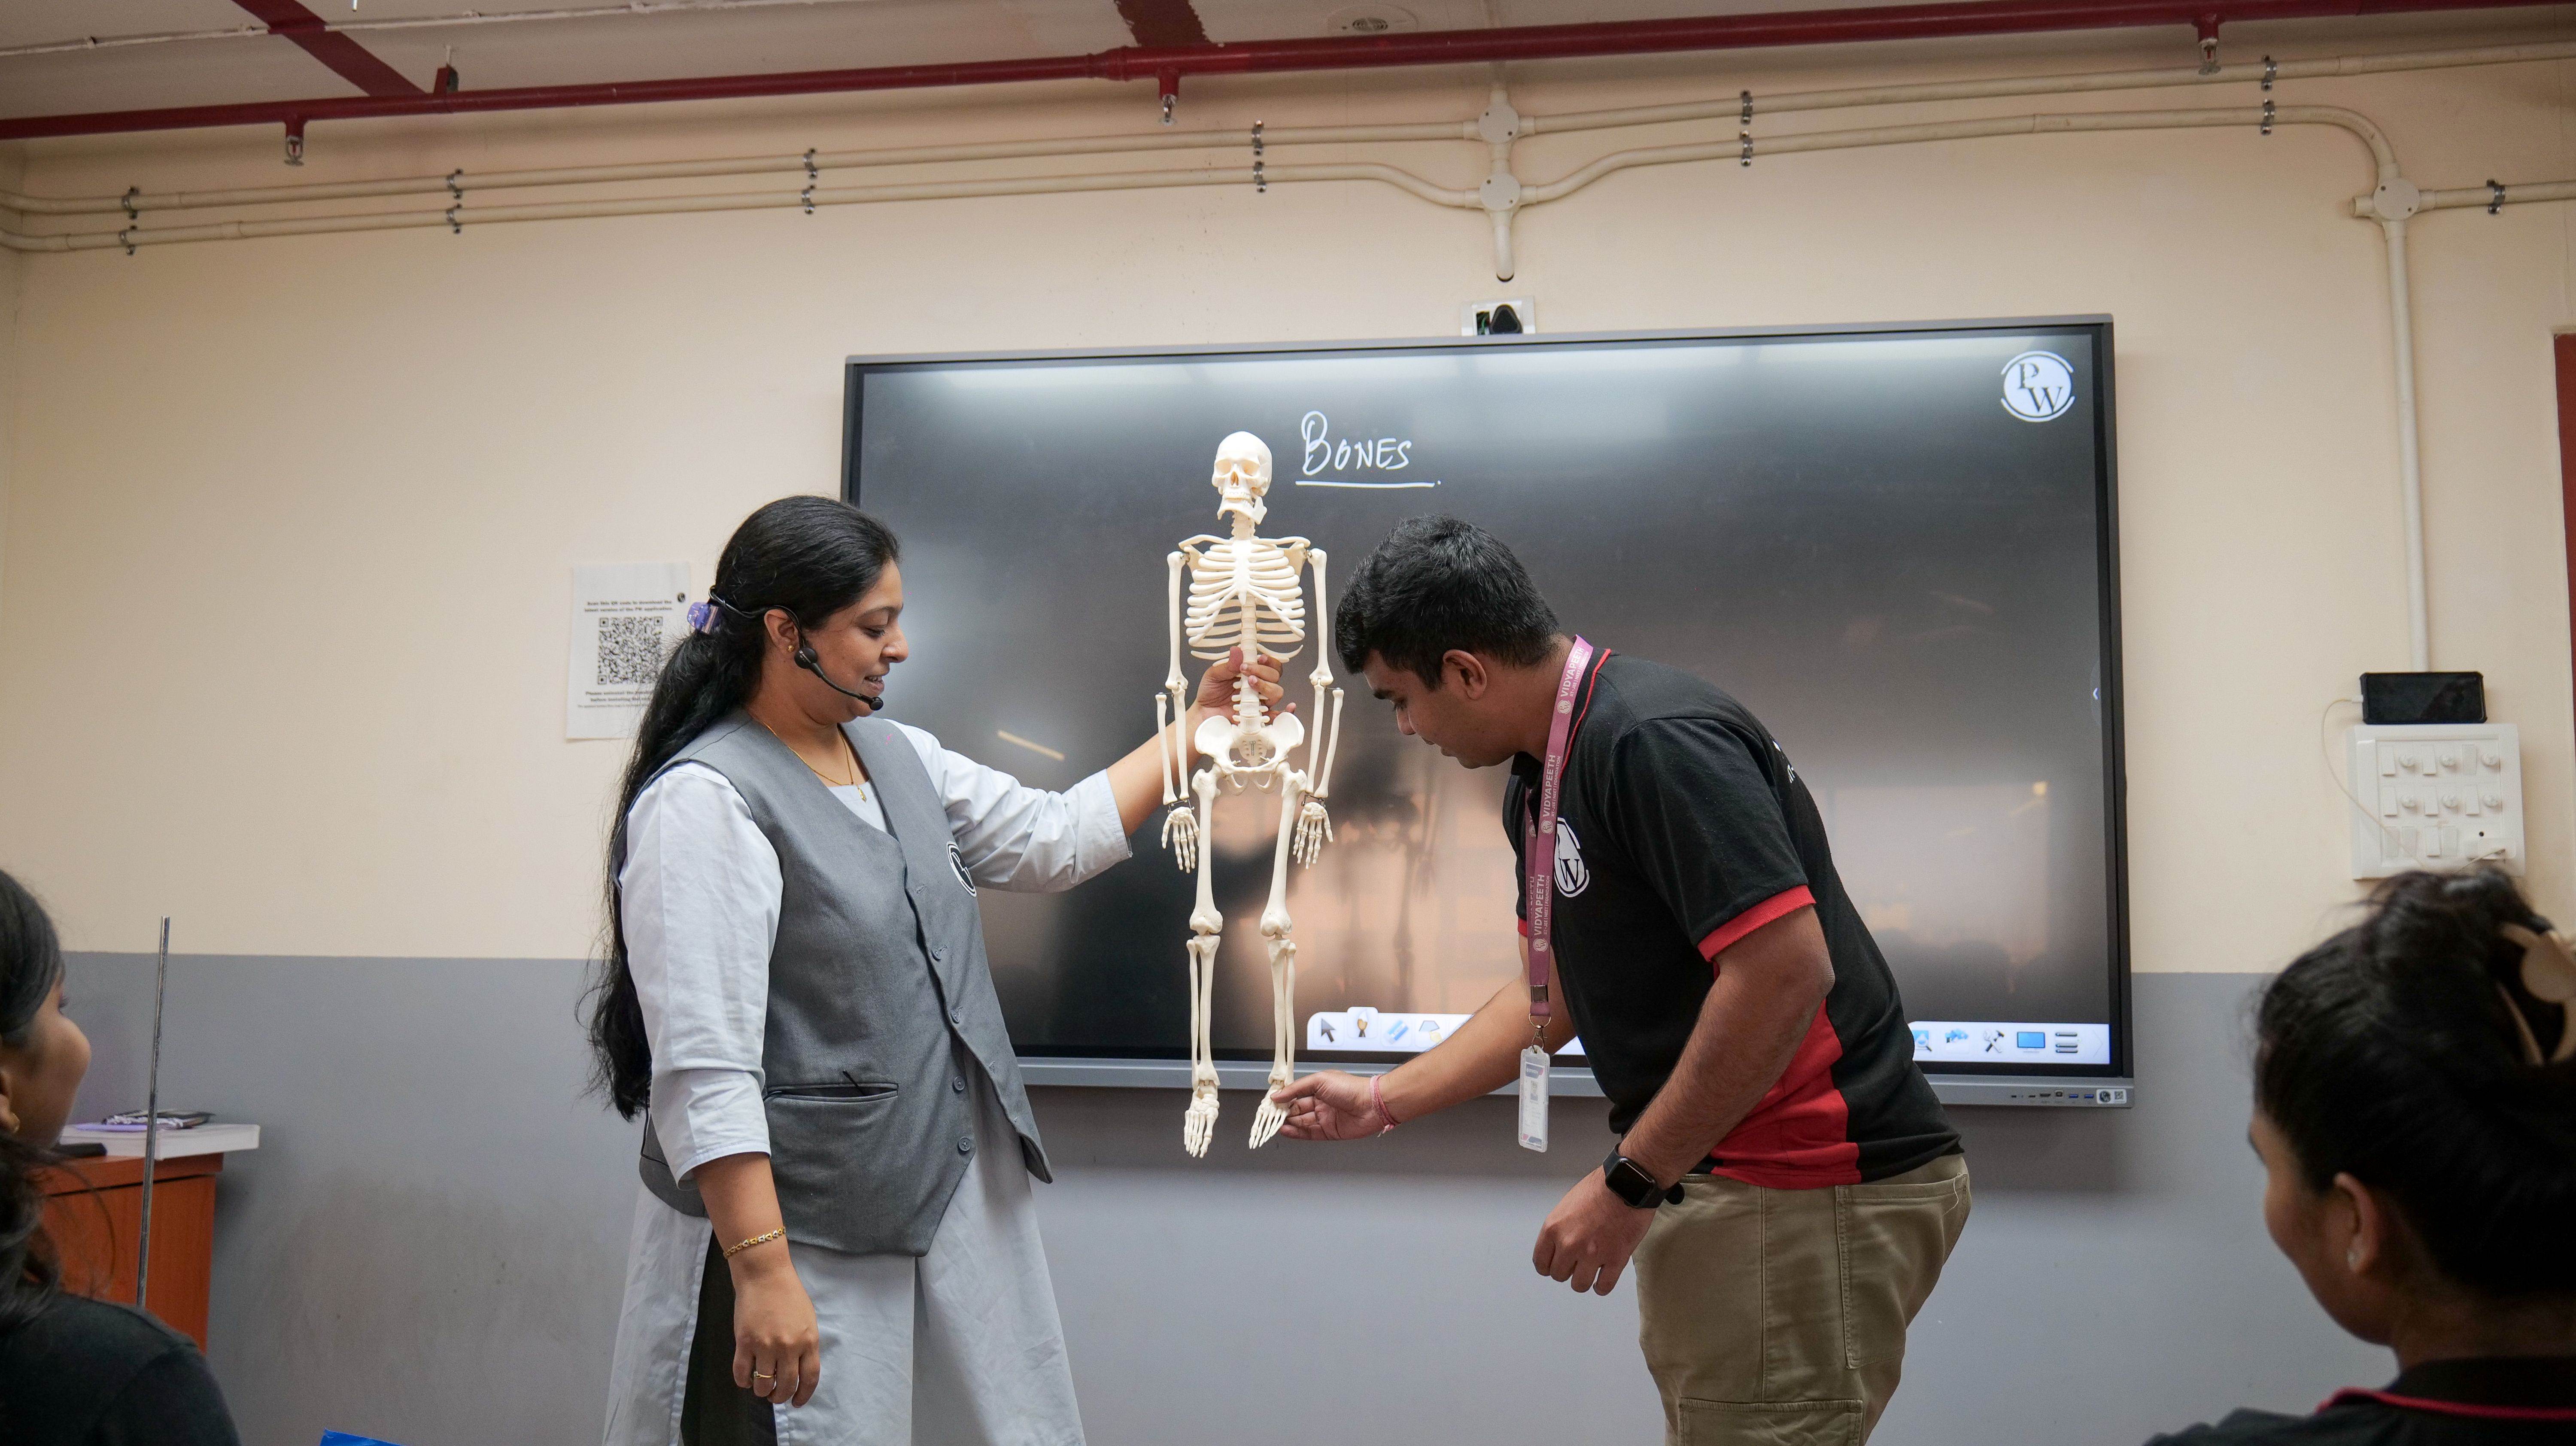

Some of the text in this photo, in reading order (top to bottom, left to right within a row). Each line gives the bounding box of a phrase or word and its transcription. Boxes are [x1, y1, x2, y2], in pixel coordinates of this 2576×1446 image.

[2017, 363, 2063, 414] PW
[1301, 410, 1412, 476] BONES
[1561, 647, 1585, 697] VIDYAPEETH
[1543, 754, 1555, 817] VIDYAPEETH
[1534, 874, 1545, 936] VIDYAPEETH
